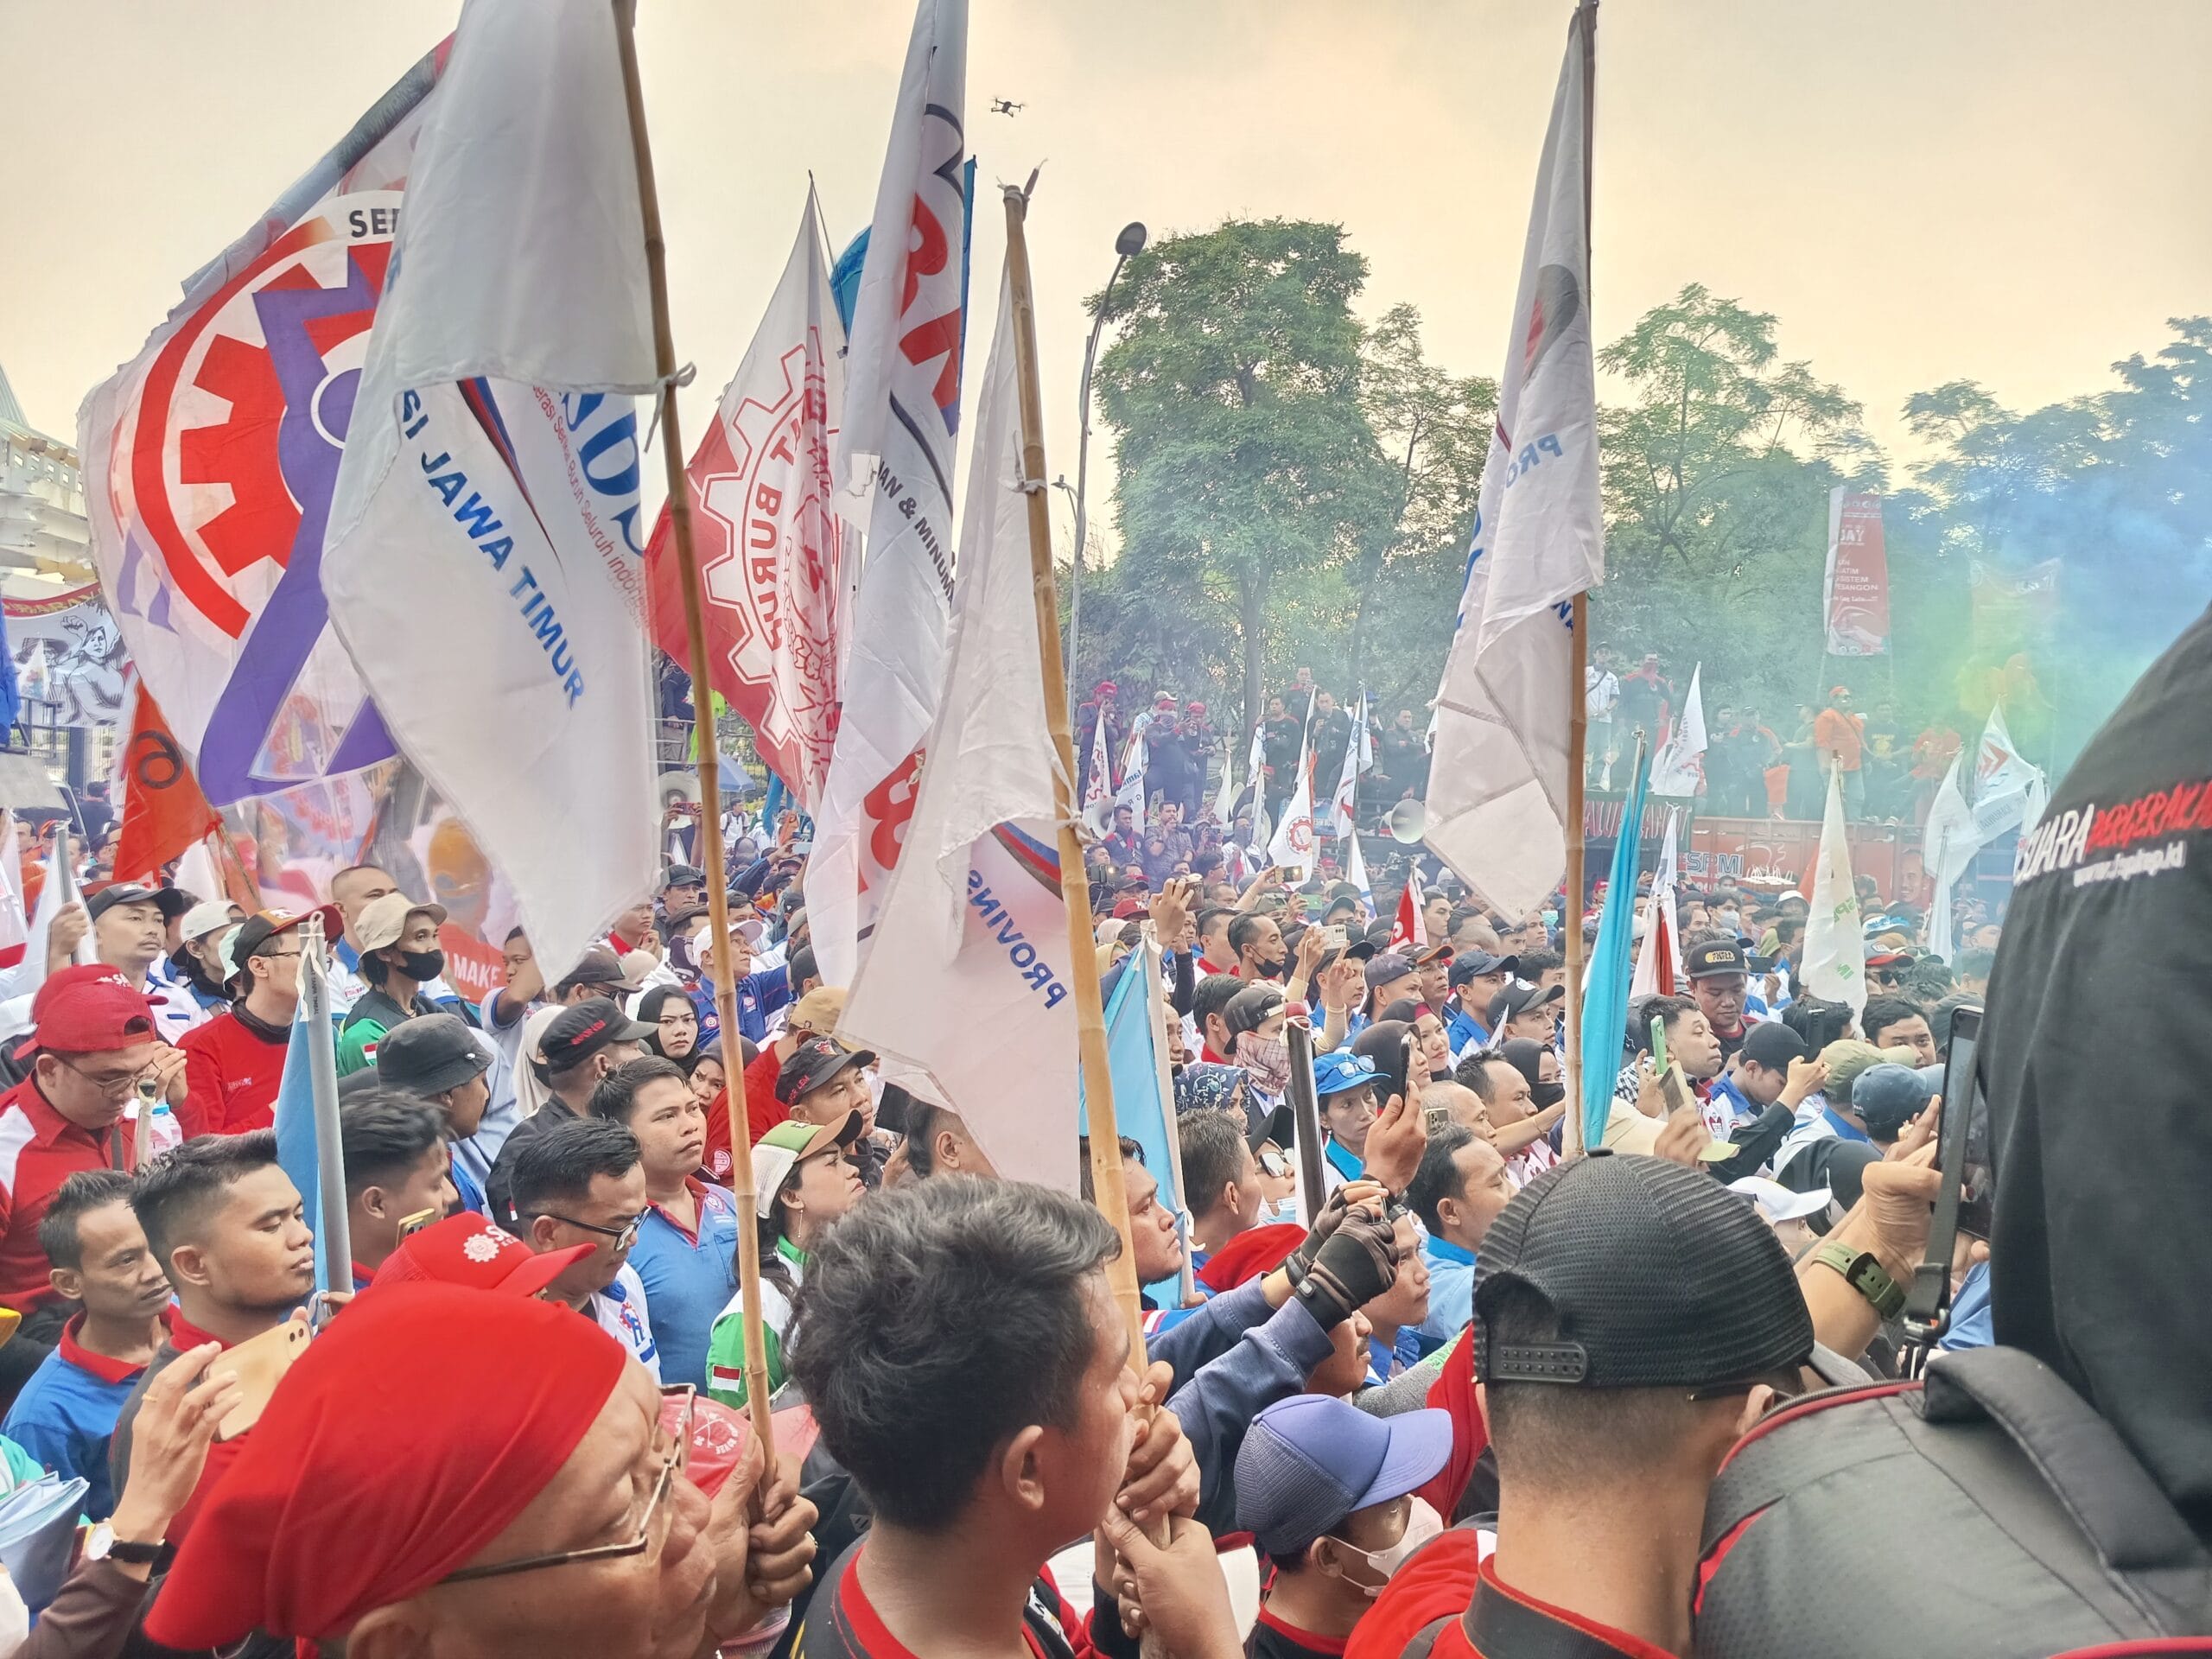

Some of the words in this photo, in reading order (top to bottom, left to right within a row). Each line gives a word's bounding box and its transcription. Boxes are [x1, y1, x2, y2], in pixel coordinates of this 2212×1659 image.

[898, 496, 918, 520] &
[421, 451, 516, 572] JAWA
[509, 564, 585, 706] TIMUR
